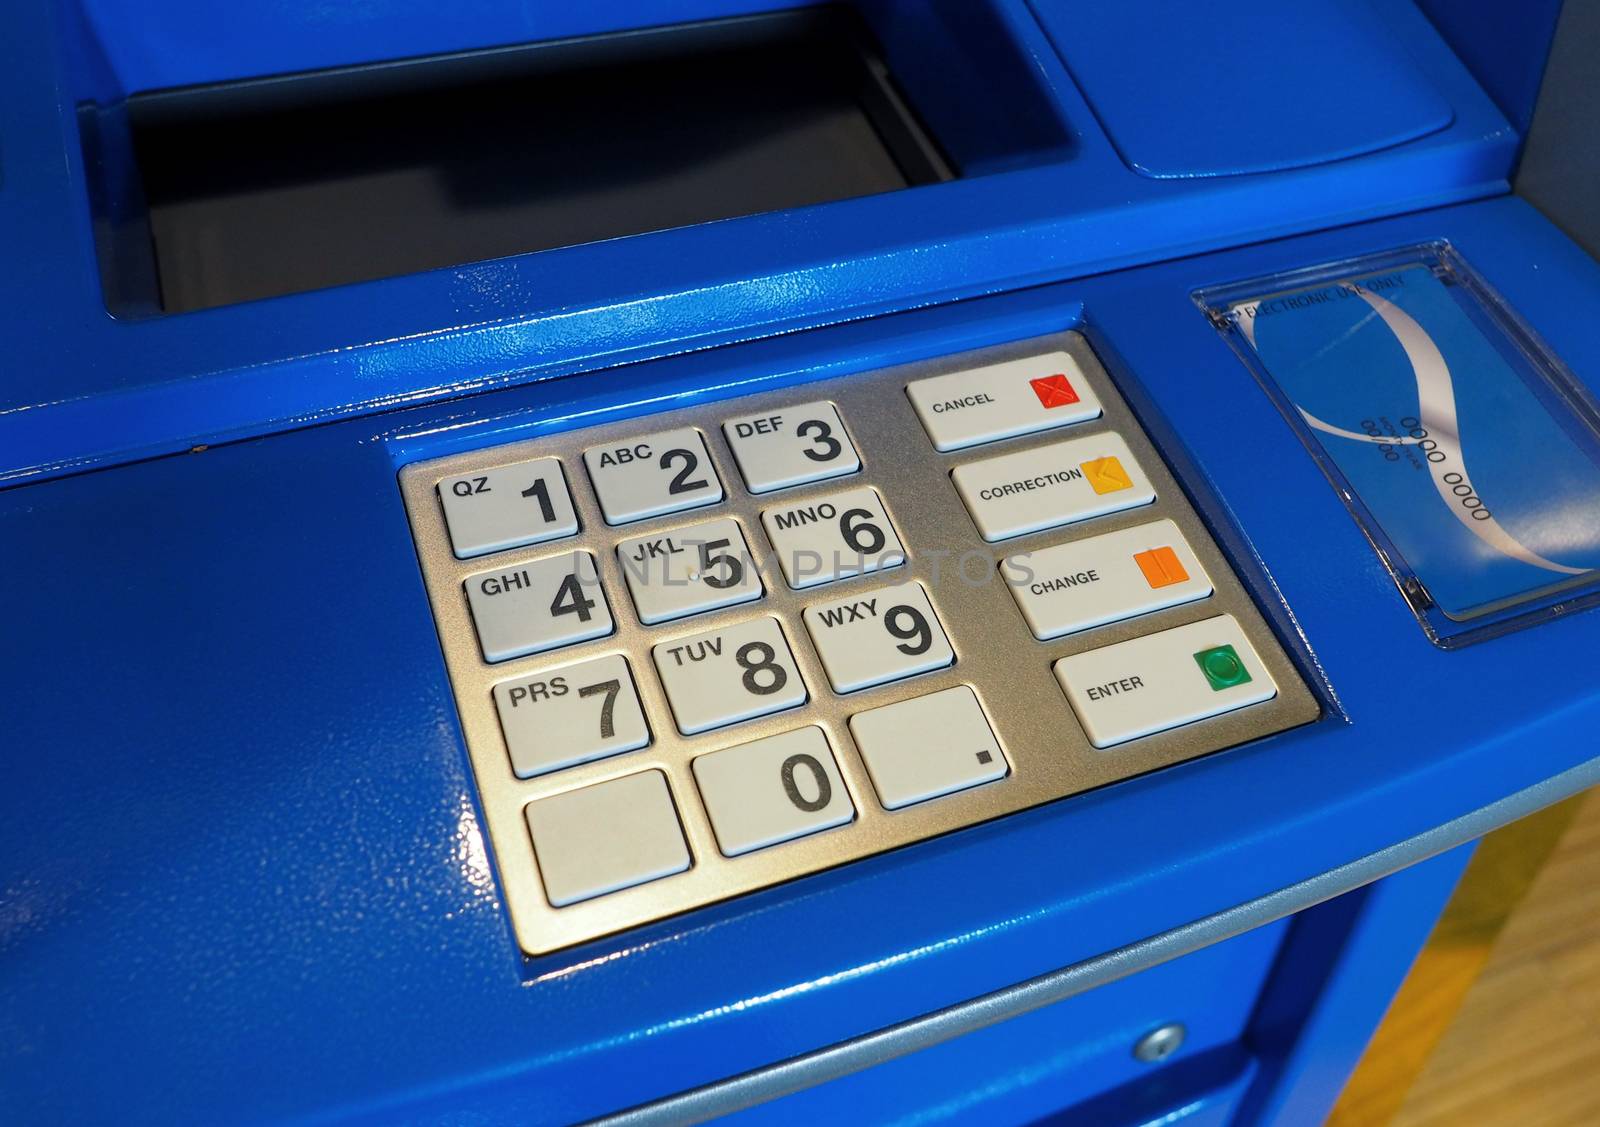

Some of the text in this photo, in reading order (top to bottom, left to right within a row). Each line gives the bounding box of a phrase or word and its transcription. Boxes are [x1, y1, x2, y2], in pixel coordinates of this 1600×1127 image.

[1245, 290, 1330, 319] ELECTRONIC
[1367, 274, 1405, 292] ONLY
[932, 393, 995, 414] CANCEL
[735, 415, 842, 462] DEF 3
[600, 444, 709, 496] ABC 2
[979, 468, 1083, 501] CORRECTION
[1401, 417, 1446, 463] 0000
[1443, 473, 1491, 520] 0000
[452, 476, 557, 523] QZ 1
[775, 504, 887, 555] MNO 6
[634, 537, 744, 590] JKL 5
[1030, 569, 1100, 596] CHANGE
[480, 570, 596, 623] GHI 4
[817, 598, 933, 656] WXY 9
[666, 636, 788, 696] TUV 8
[1086, 675, 1144, 701] ENTER
[509, 676, 620, 738] PRS 7
[780, 753, 833, 813] 0
